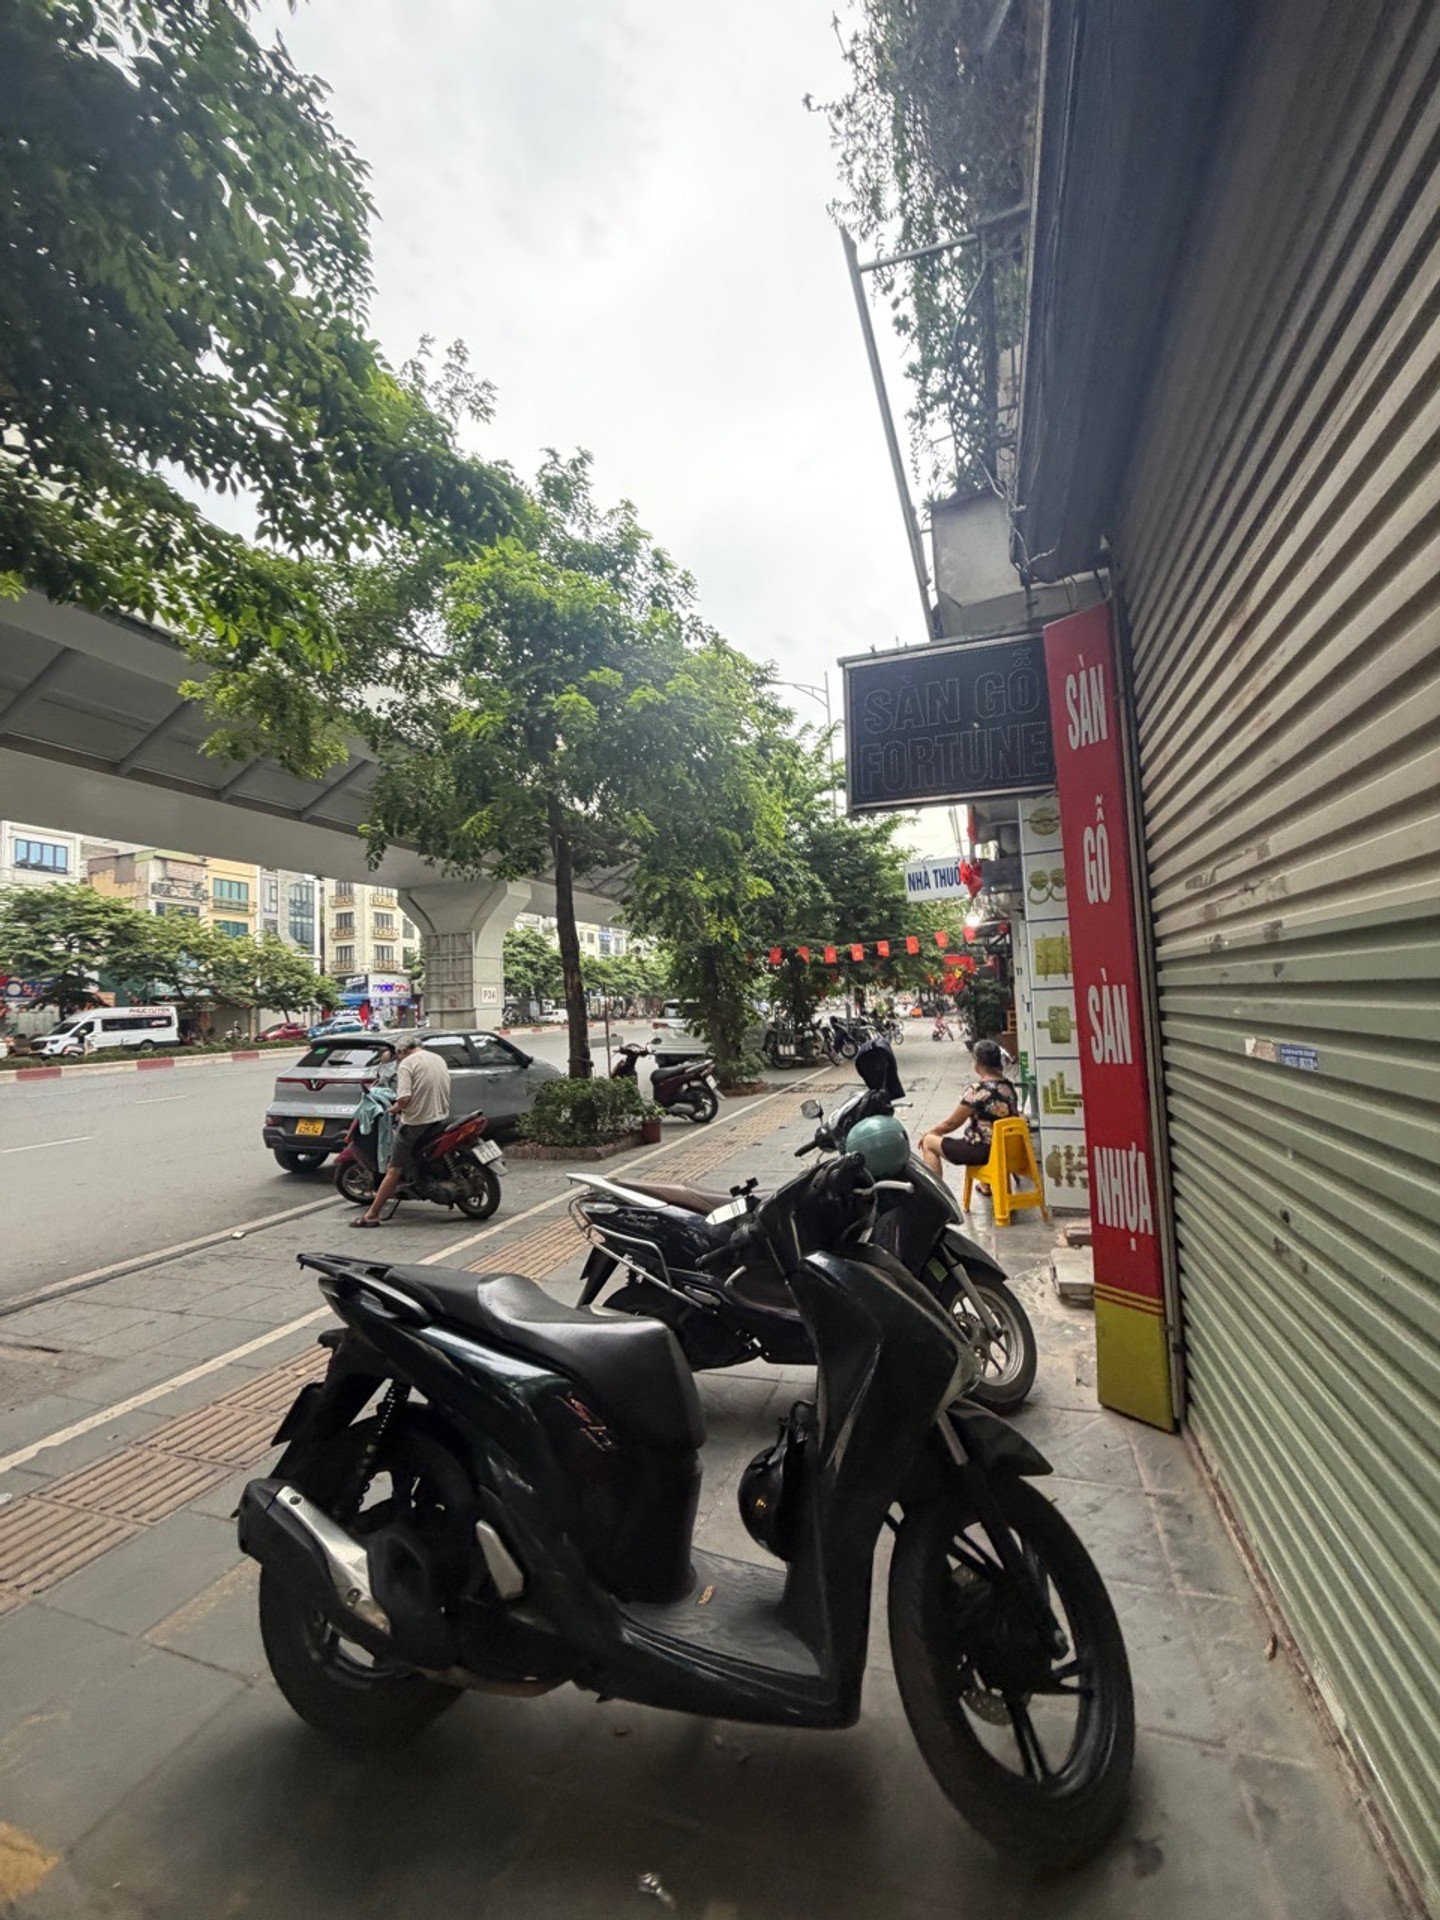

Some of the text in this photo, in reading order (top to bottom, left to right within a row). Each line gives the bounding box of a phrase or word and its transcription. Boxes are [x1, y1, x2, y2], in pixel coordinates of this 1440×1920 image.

[863, 647, 1041, 735] SÀN GỖ
[1066, 654, 1108, 750] SÀN
[860, 721, 1050, 795] FORTUNE
[907, 859, 961, 892] NHÀ THUỐ
[1083, 794, 1111, 904] GỖ
[1088, 967, 1133, 1065] SÀN
[1094, 1141, 1154, 1252] NHỰA
